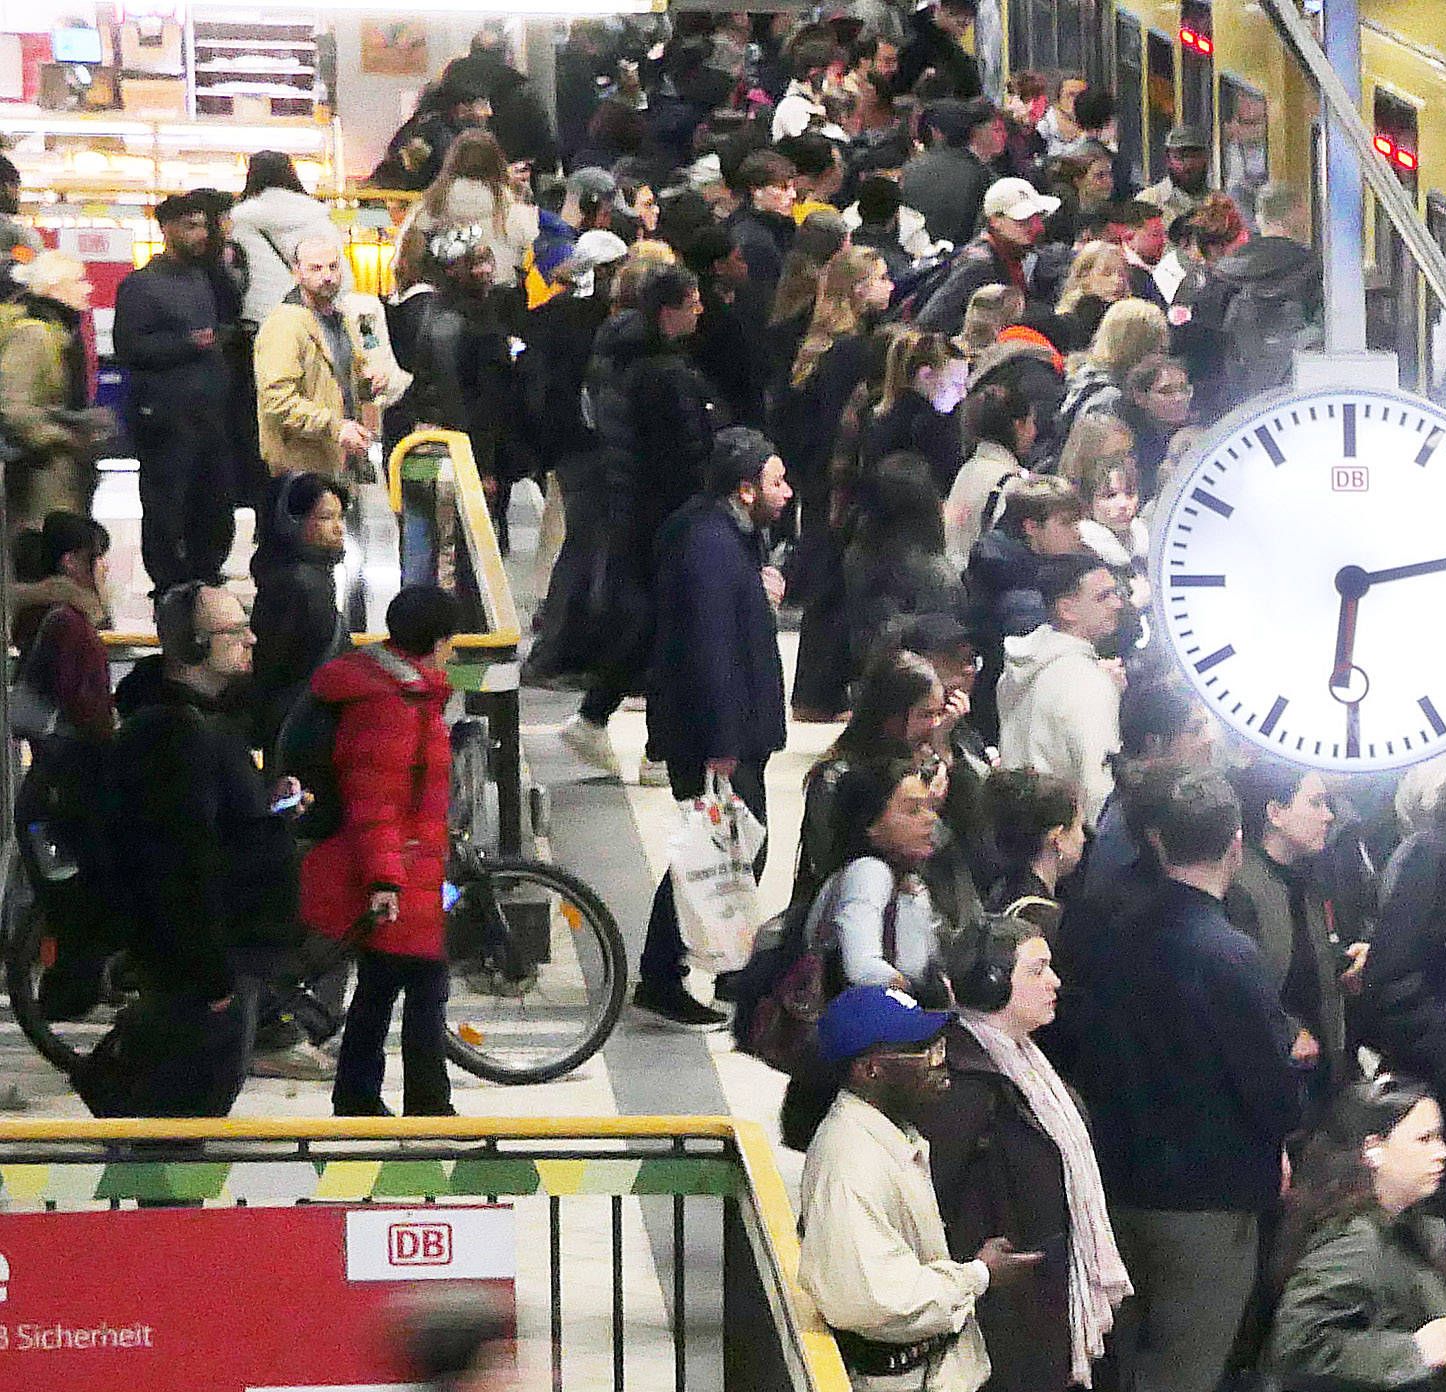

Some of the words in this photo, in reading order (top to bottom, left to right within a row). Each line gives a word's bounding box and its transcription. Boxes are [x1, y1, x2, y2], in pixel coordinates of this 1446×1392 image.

[1335, 469, 1365, 489] DB
[394, 1226, 448, 1260] DB
[16, 1321, 154, 1350] Sicherheit
